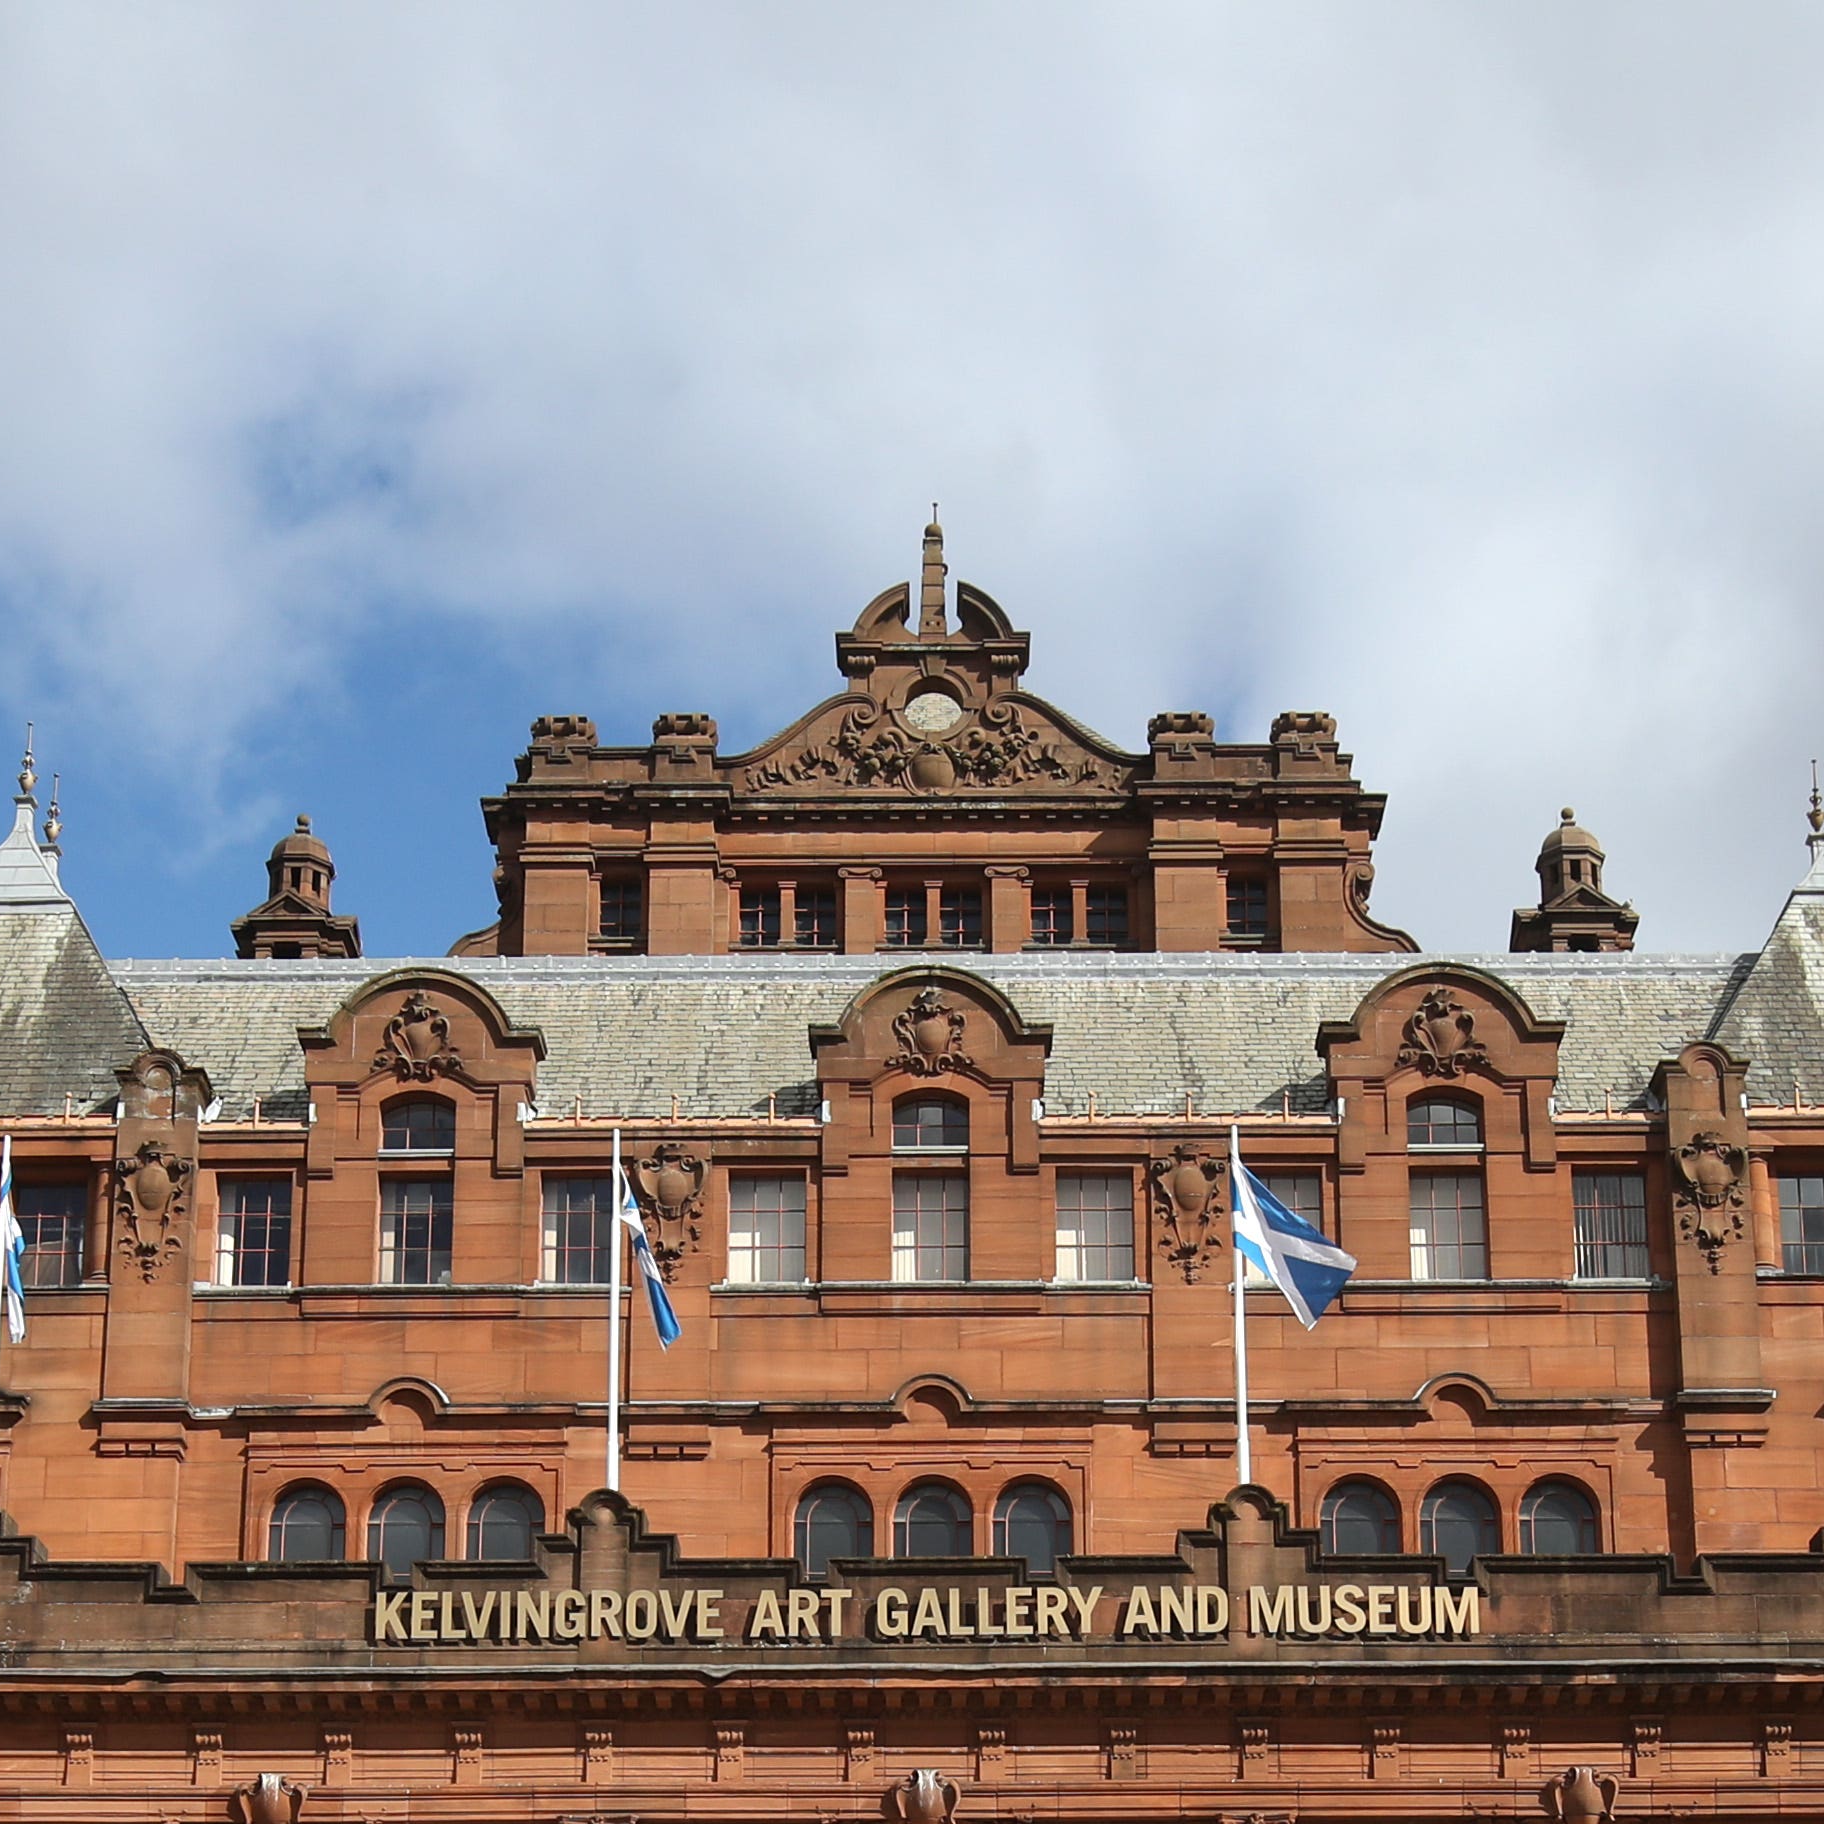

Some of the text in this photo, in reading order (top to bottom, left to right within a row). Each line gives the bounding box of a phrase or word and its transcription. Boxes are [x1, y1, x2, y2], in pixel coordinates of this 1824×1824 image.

[375, 1583, 1481, 1640] KELVINGROVE ART GALLERY AND MUSEUM
